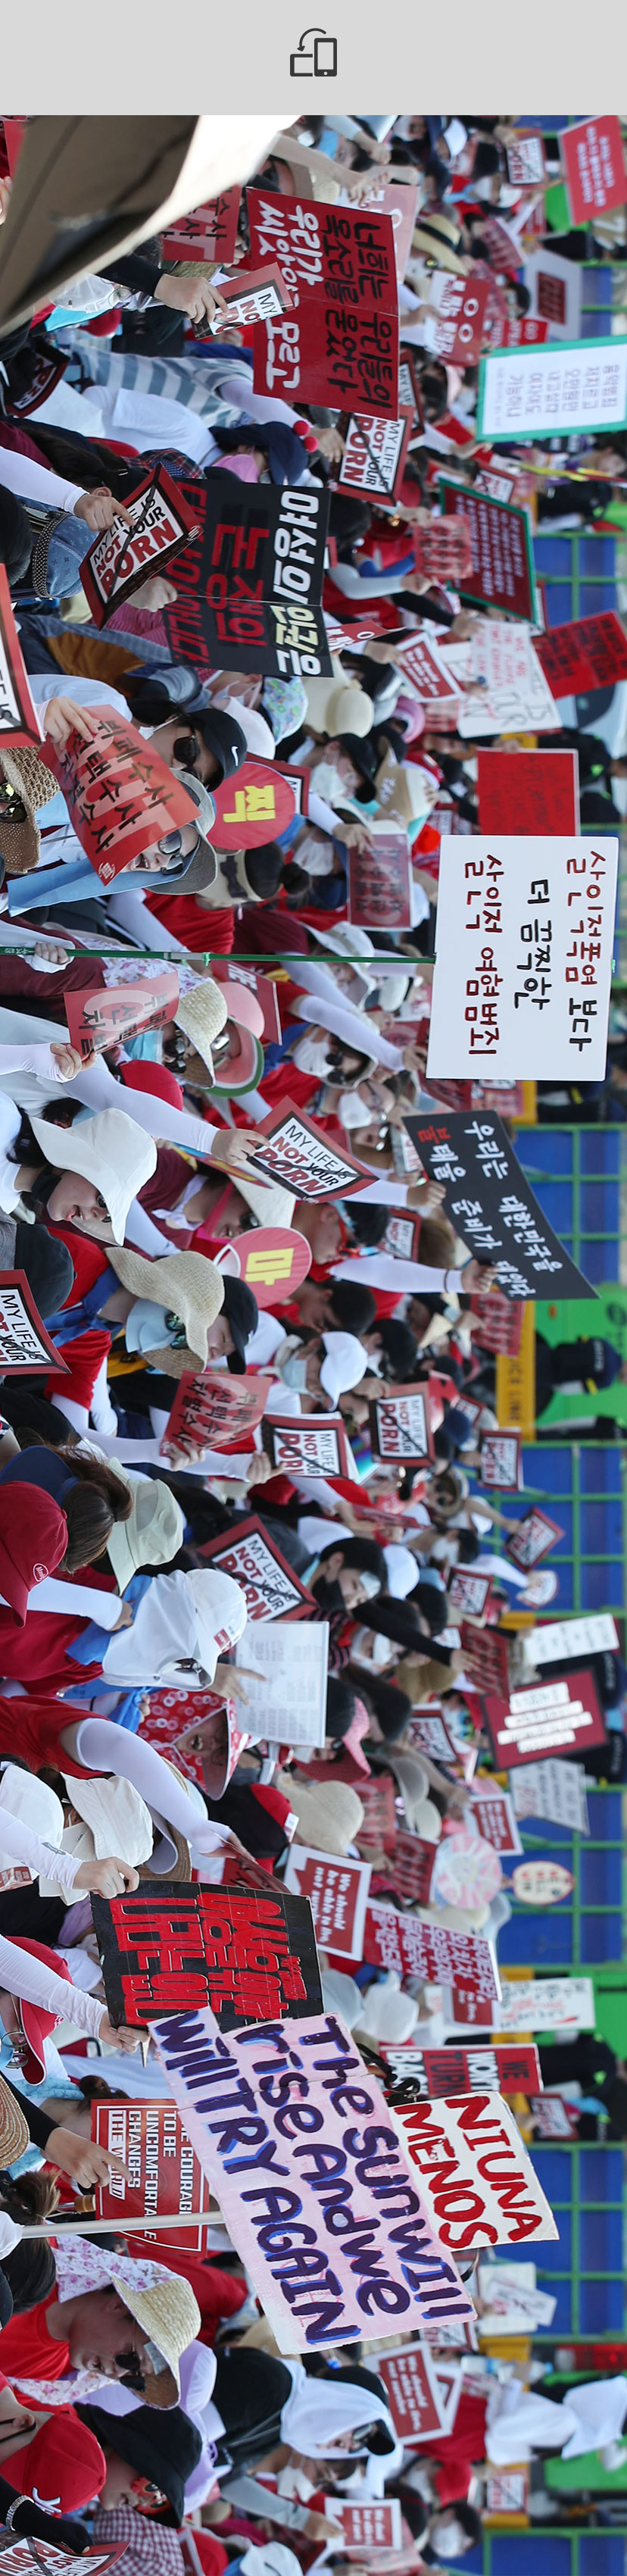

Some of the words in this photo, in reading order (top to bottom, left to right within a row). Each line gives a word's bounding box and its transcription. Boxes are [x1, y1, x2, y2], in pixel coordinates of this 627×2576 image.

[287, 205, 324, 286] 우리가
[321, 215, 358, 305] 목소리를
[354, 222, 388, 299] 너희는
[265, 317, 300, 390] 모르고
[357, 312, 392, 408] 우리들의
[343, 417, 373, 483] PORN
[373, 420, 387, 452] NOT
[388, 422, 400, 444] MY
[365, 456, 381, 486] YOUR
[382, 446, 395, 473] LIFE
[92, 541, 109, 564] MY
[95, 536, 121, 577] NOT
[100, 518, 178, 597] PORN
[273, 491, 320, 605] 여성의
[205, 524, 270, 646] 논쟁의
[270, 605, 321, 676] 인권은
[73, 732, 143, 830] 선택수사
[97, 721, 175, 809] 뷔페수사
[223, 785, 276, 823] 찍
[465, 854, 504, 933] 살인적
[528, 880, 550, 904] 더
[566, 851, 606, 986] 살인적폭염
[514, 918, 553, 1011] 끔찍한
[465, 947, 504, 1055] 여혐범죄
[568, 998, 597, 1052] 보다
[253, 1148, 327, 1193] PORN
[271, 1136, 309, 1164] NOT
[307, 1162, 339, 1186] YOUR
[285, 1124, 313, 1148] MY
[307, 1146, 338, 1171] LIFE
[417, 1125, 466, 1182] 불태울
[451, 1199, 503, 1249] 준비가
[463, 1121, 509, 1179] 우리는
[498, 1195, 563, 1272] 대한민국을
[245, 1248, 295, 1286] 마
[0, 1295, 23, 1318] MY
[11, 1323, 37, 1349] LIFE
[173, 1379, 207, 1443] 차별수사
[380, 1403, 400, 1454] PORN
[399, 1402, 410, 1426] NOT
[277, 1433, 304, 1474] PORN
[303, 1433, 318, 1455] NOT
[320, 1433, 333, 1449] MY
[320, 1450, 335, 1467] LIFE
[216, 1553, 273, 1622] PORN
[235, 1546, 262, 1578] NOT
[257, 1580, 285, 1611] YOUR
[248, 1540, 267, 1561] MY
[259, 1563, 287, 1590] LIFE
[312, 1867, 324, 1889] not
[322, 1888, 335, 1914] able
[326, 1870, 339, 1886] be
[338, 1873, 352, 1892] We
[320, 1916, 331, 1926] to
[333, 1894, 348, 1930] should
[448, 1930, 475, 1980] 외치자
[429, 2052, 468, 2096] TURN
[501, 2061, 529, 2080] WE
[111, 2111, 124, 2143] THE
[163, 2111, 176, 2131] TO
[110, 2146, 123, 2198] WRLD
[127, 2111, 142, 2188] CHANGES
[163, 2136, 176, 2158] BE
[144, 2111, 159, 2240] UNCOMFORTAE
[179, 2146, 194, 2215] COURAG
[395, 2102, 498, 2249] MENOS
[240, 2187, 362, 2345] AGAIN
[46, 2556, 82, 2569] NOT
[76, 2559, 102, 2569] MY
